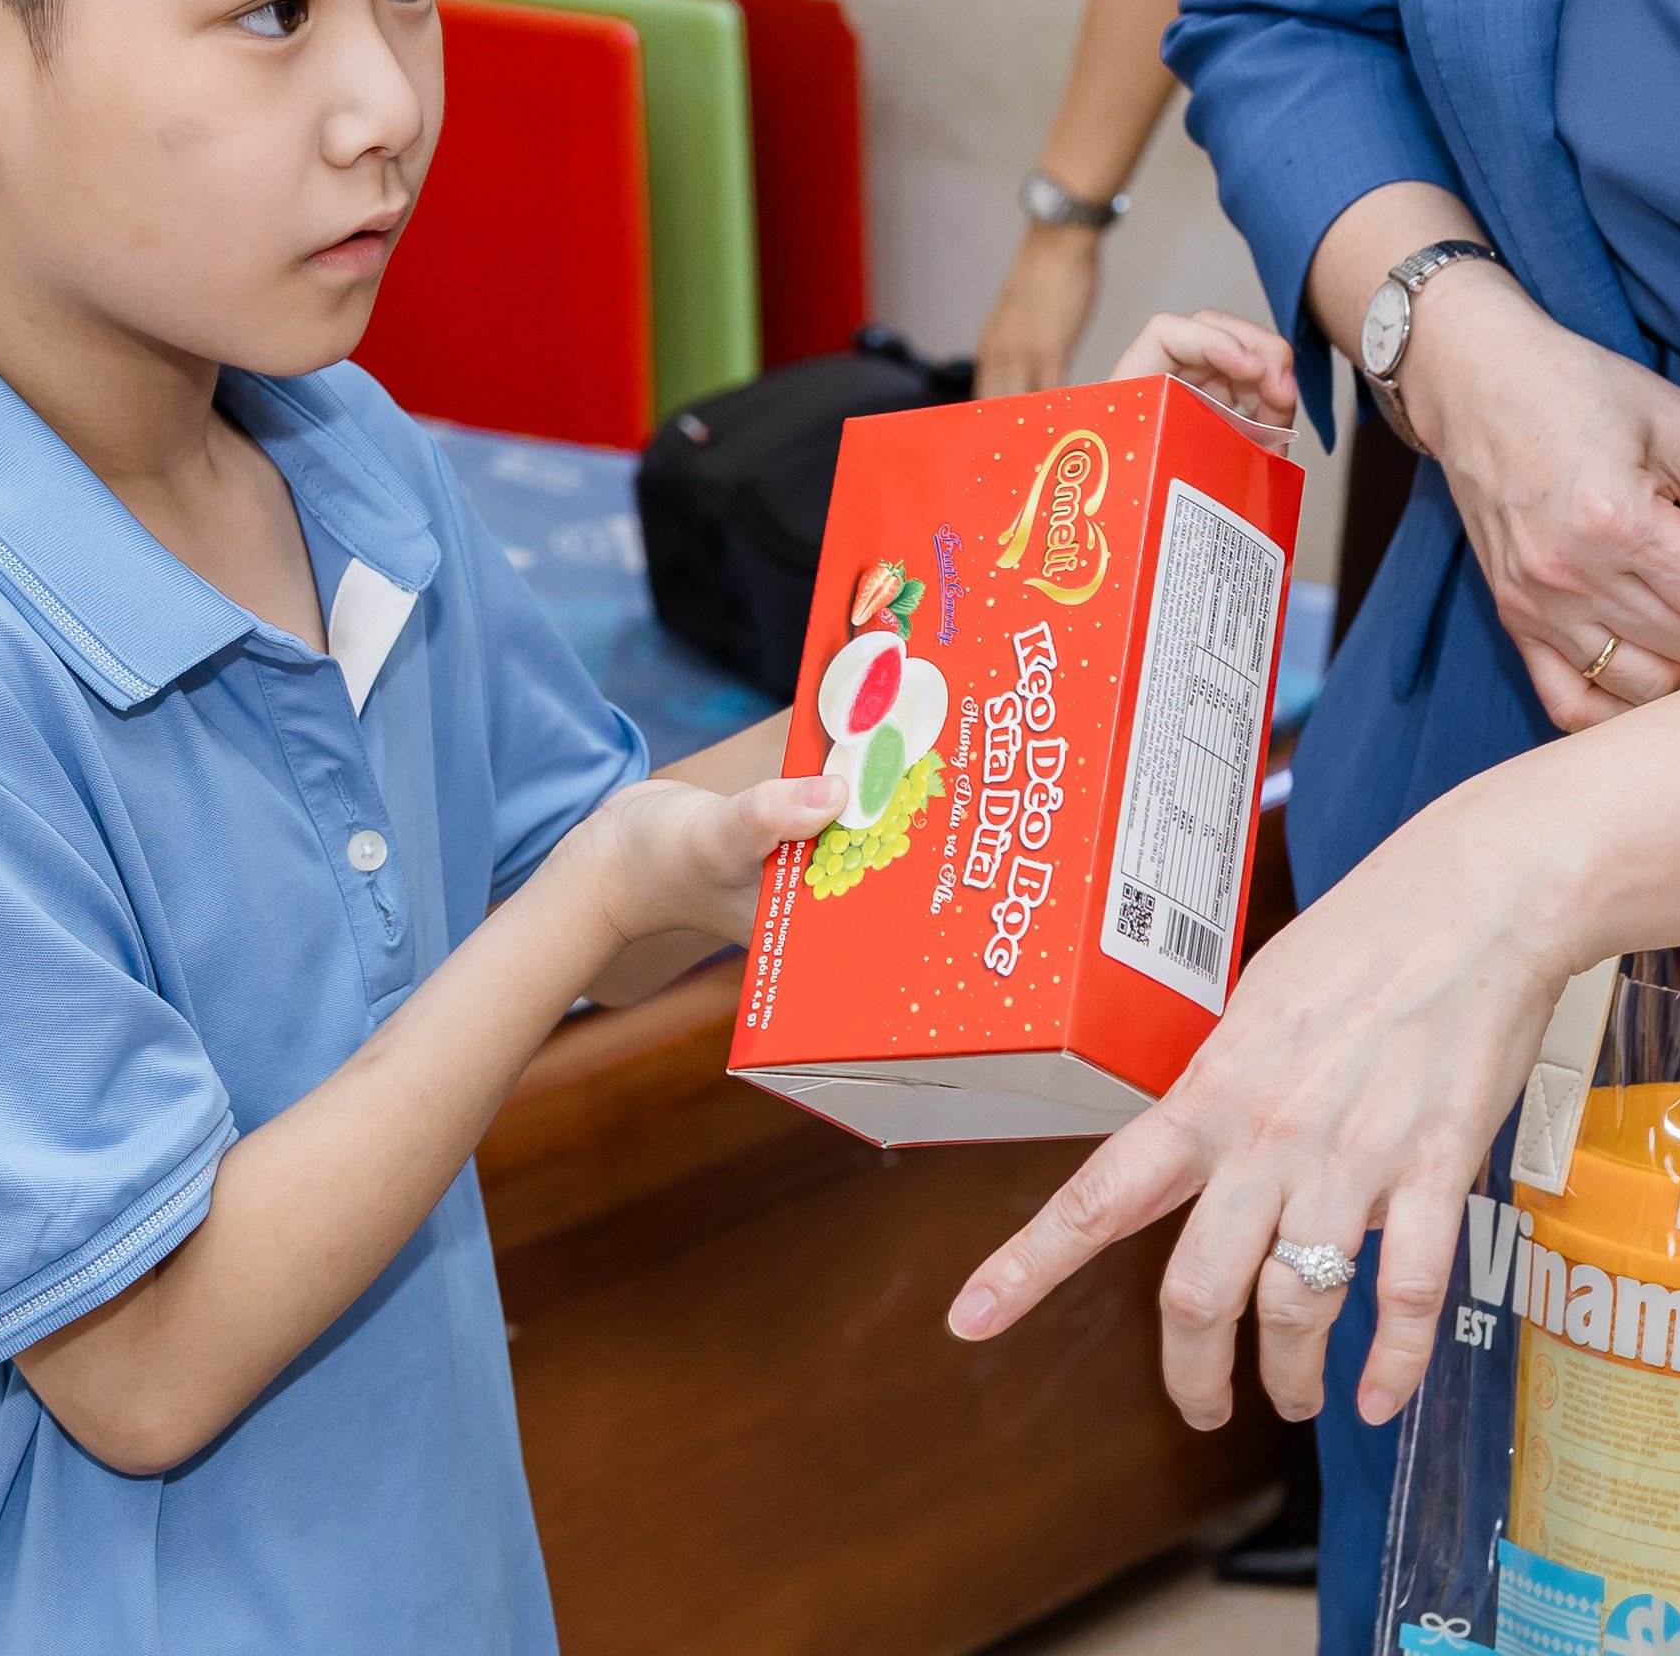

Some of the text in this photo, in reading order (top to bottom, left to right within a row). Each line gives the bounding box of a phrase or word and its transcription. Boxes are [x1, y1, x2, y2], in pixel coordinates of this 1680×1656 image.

[1041, 449, 1092, 578] Omeli
[937, 523, 964, 647] Fruit Candy
[929, 695, 981, 917] Hương Dâu và Nho
[962, 690, 1024, 890] Sữa Dừa
[983, 621, 1067, 978] Kẹo Dẻo Bọc
[769, 895, 781, 918] 240
[777, 842, 790, 867] ợng
[760, 1004, 773, 1031] Nho
[1454, 1305, 1498, 1351] EST
